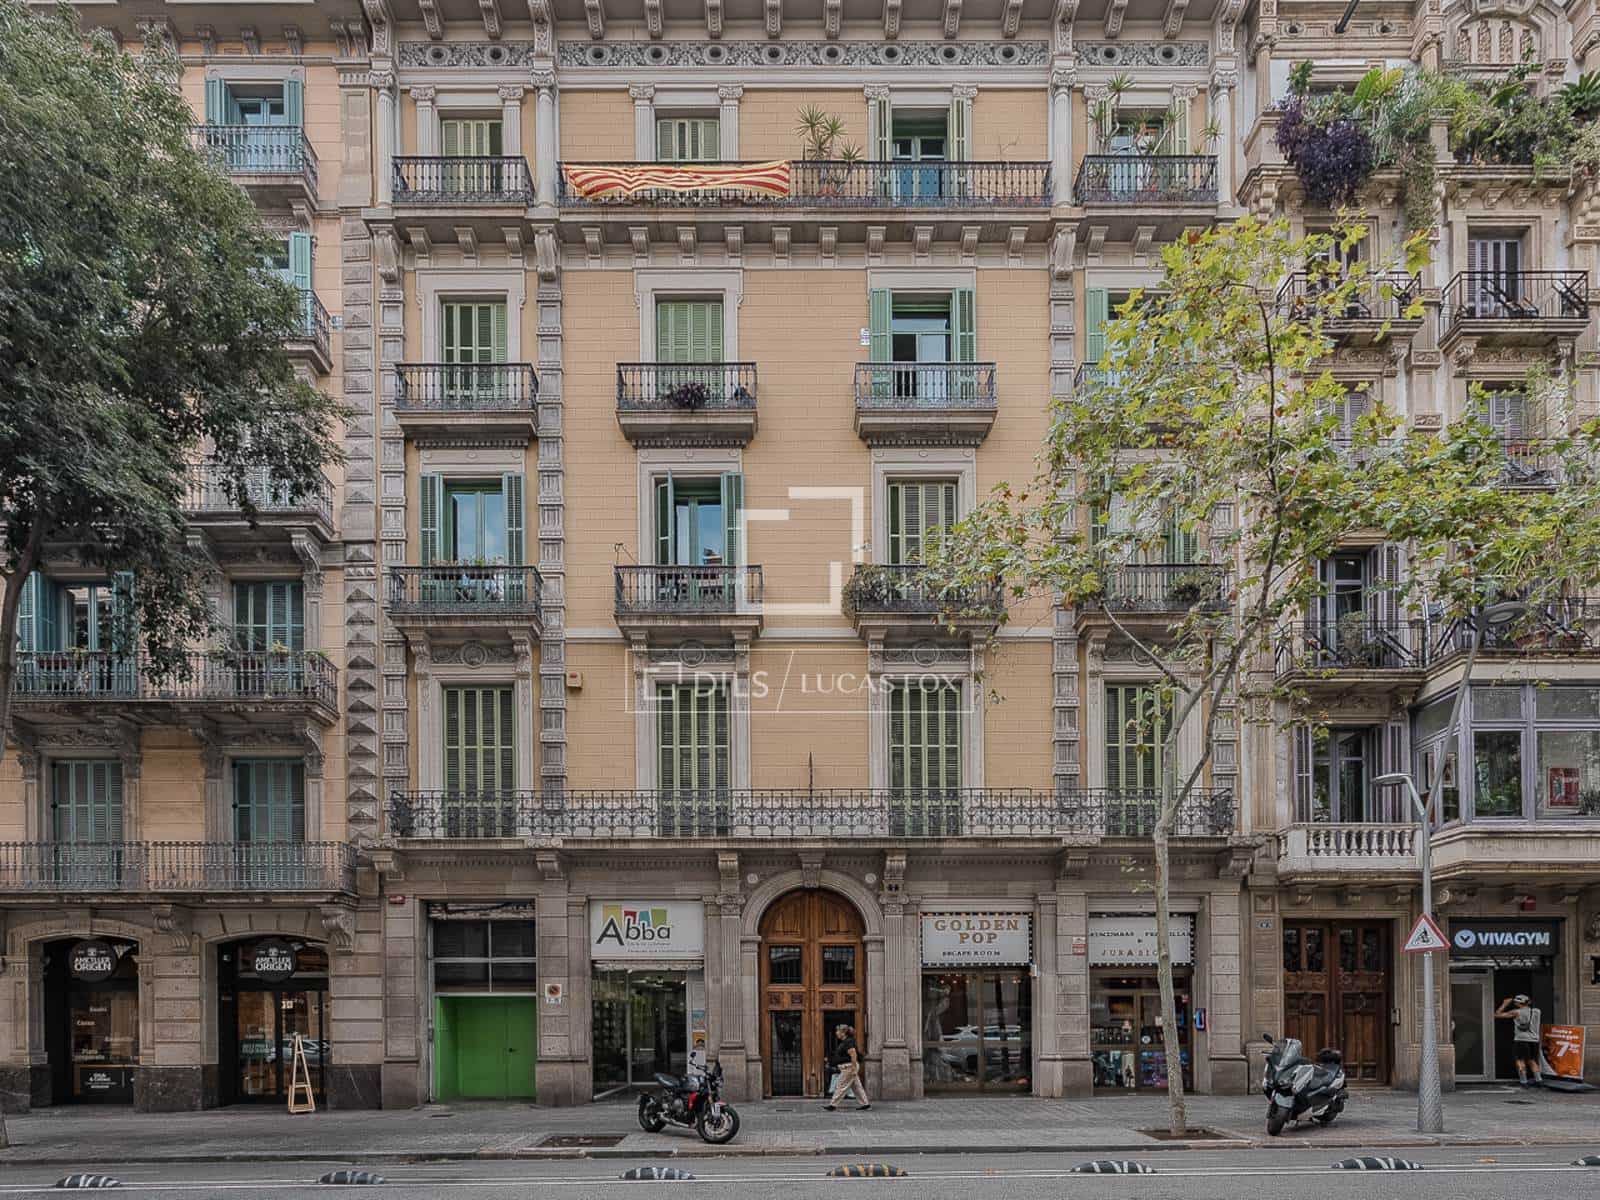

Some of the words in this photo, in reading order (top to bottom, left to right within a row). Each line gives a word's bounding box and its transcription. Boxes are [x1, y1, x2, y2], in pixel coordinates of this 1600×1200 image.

[934, 919, 1019, 931] GOLDEN
[596, 917, 671, 946] Abba
[959, 932, 998, 944] POP
[1477, 932, 1550, 945] VIVAGYM
[74, 962, 112, 971] ORIGEN
[256, 962, 293, 971] ORIGEN
[1556, 1041, 1570, 1057] 7
